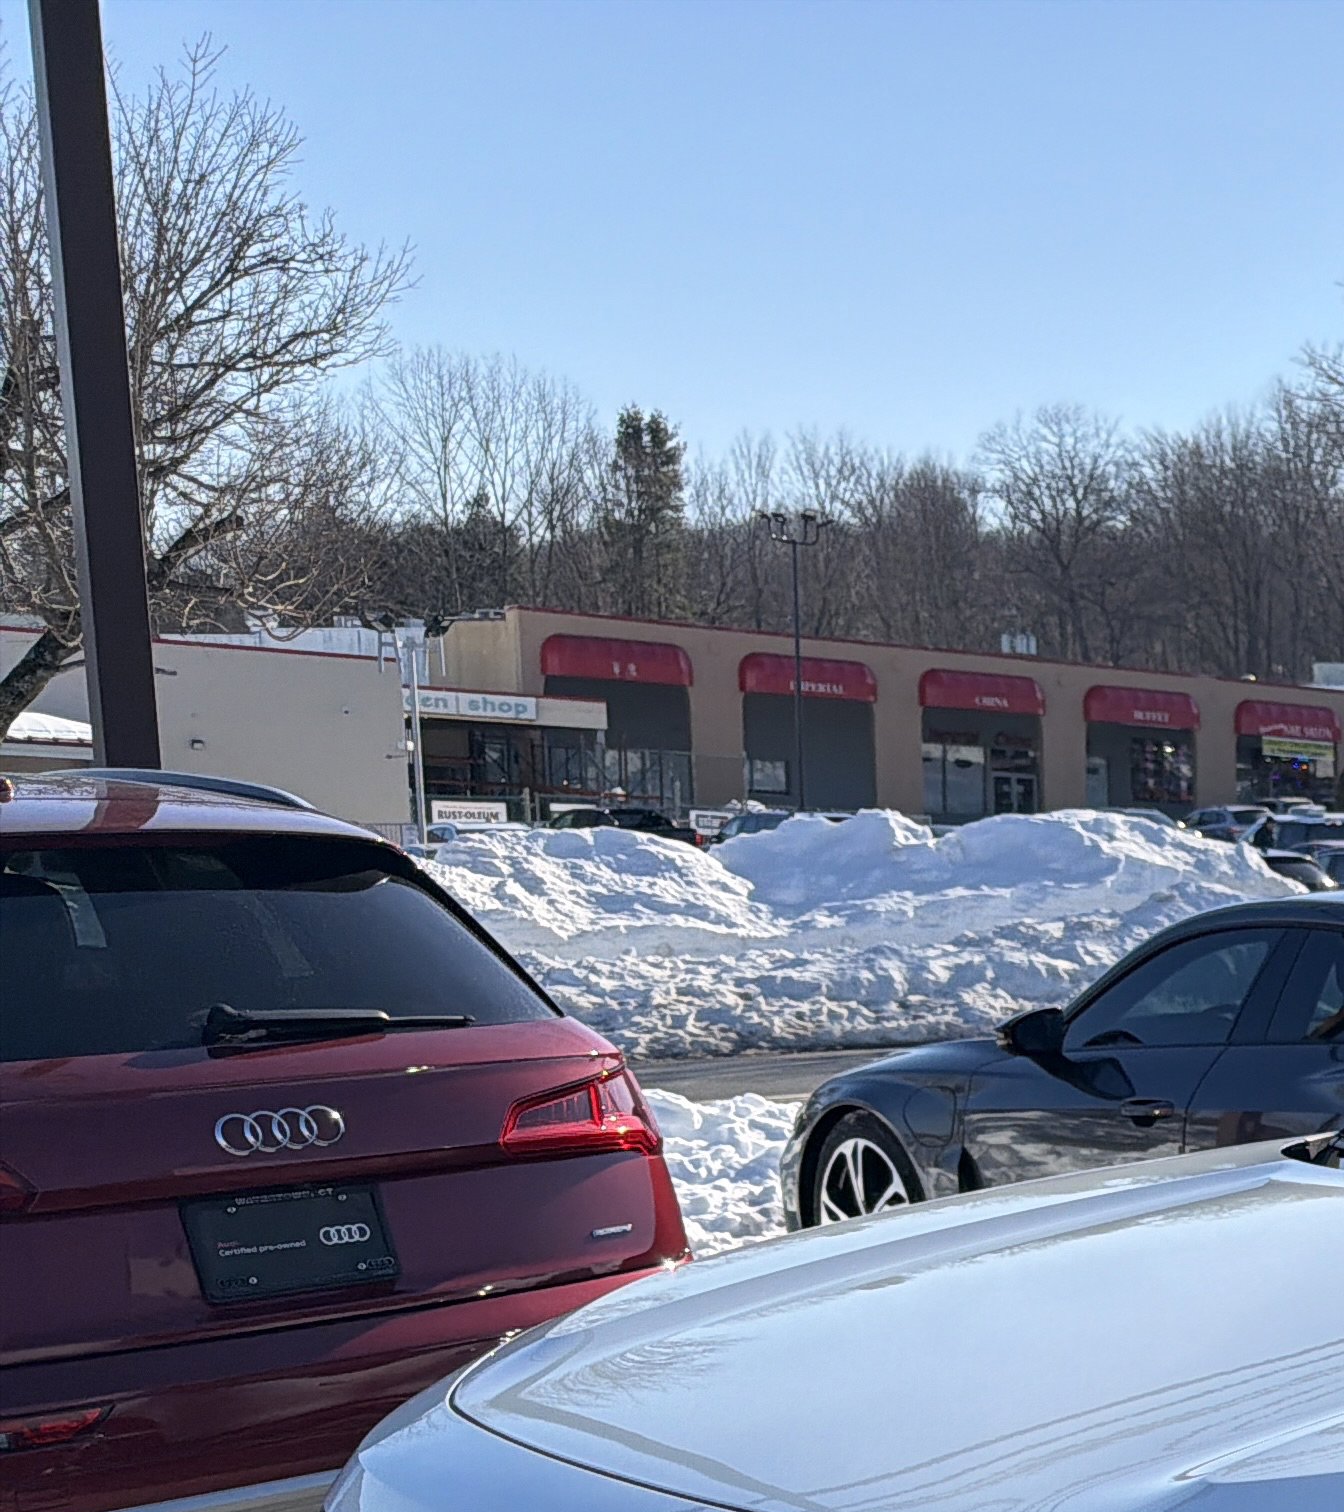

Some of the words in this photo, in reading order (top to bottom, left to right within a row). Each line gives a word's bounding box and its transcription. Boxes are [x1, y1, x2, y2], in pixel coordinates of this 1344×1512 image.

[467, 697, 528, 719] shop
[437, 809, 500, 821] RUST-OLEUM
[219, 1246, 258, 1257] Certified
[259, 1239, 306, 1253] pre-owned
